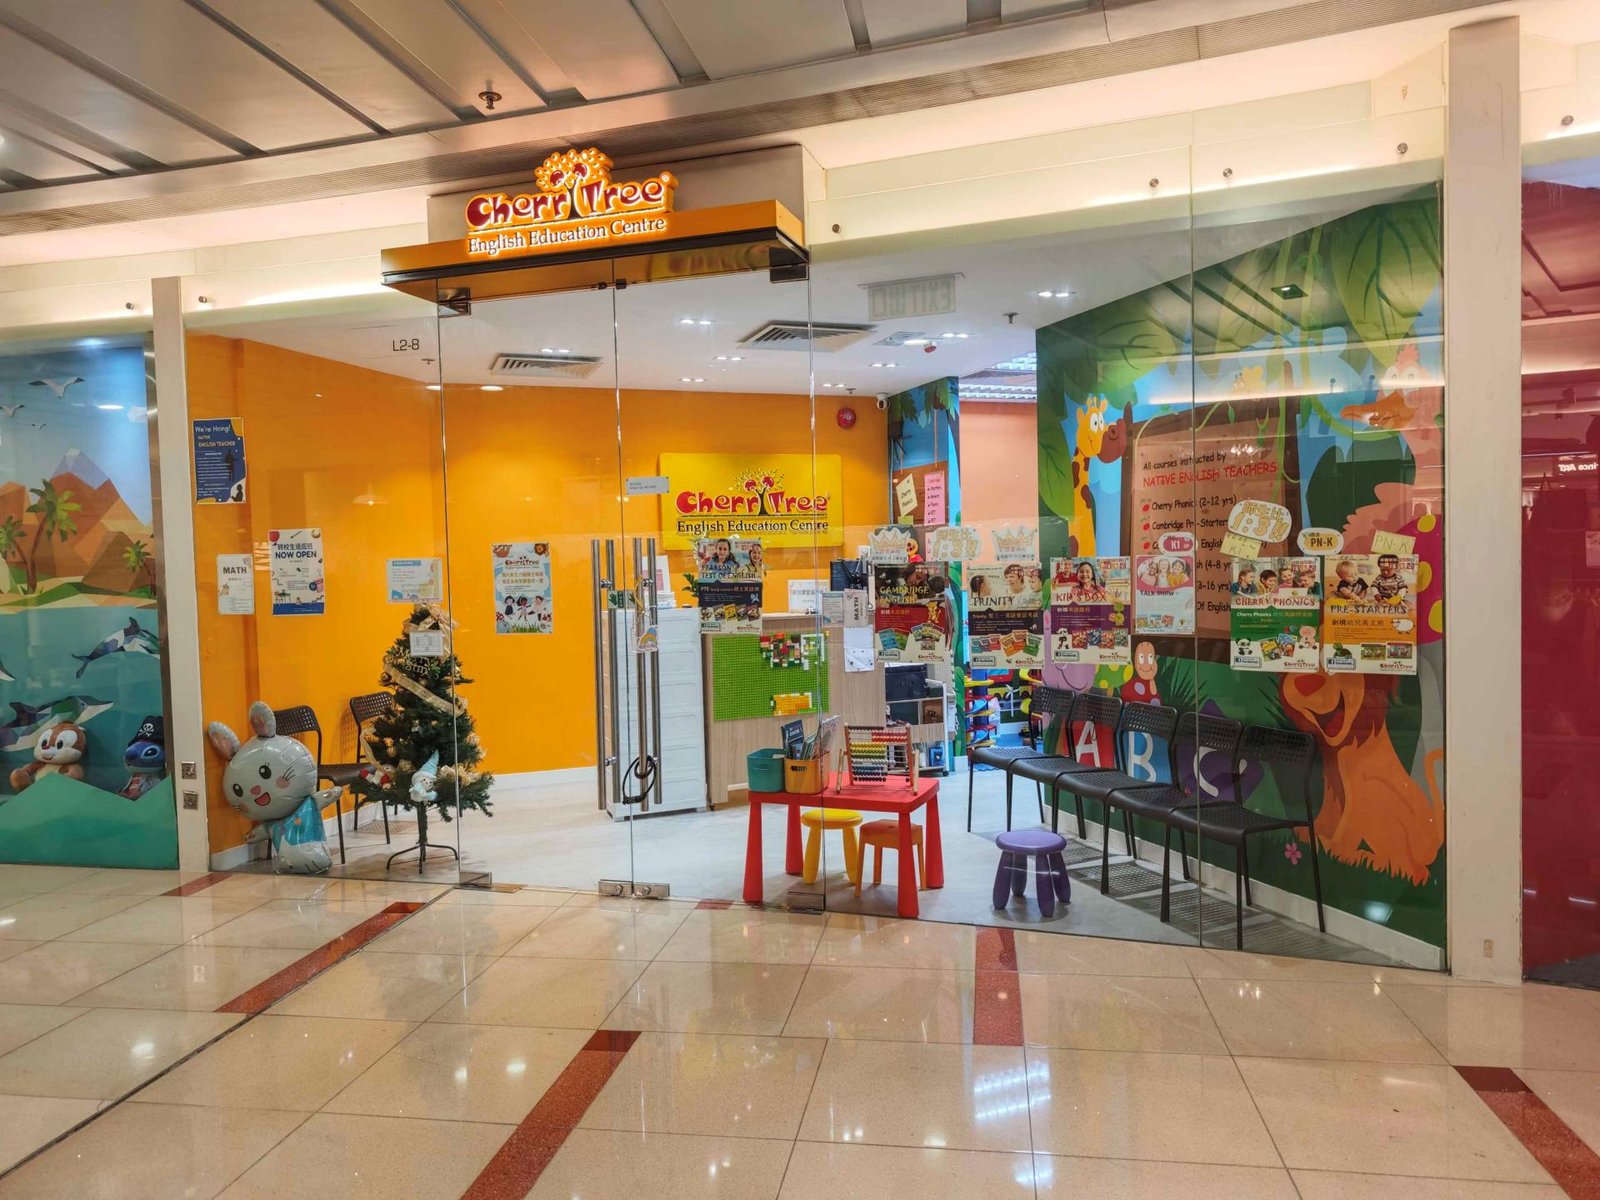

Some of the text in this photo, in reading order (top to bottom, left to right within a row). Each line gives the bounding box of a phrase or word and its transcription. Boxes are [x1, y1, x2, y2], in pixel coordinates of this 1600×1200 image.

[580, 178, 665, 214] Tree
[468, 217, 665, 255] English Education Centre
[392, 338, 420, 352] L2-8
[195, 424, 231, 433] We're Hiring!
[1143, 461, 1151, 470] All
[1154, 460, 1177, 469] courses
[1217, 451, 1226, 463] by
[1143, 473, 1176, 487] NATIVE
[1224, 461, 1277, 478] TEACHERS
[768, 491, 828, 514] Tree
[1152, 501, 1172, 511] Cherry
[1200, 496, 1219, 508] (2-12
[1222, 495, 1236, 506] yrs)
[677, 520, 724, 535] English
[728, 519, 787, 531] Education
[1152, 520, 1184, 531] Cambridge
[1171, 540, 1179, 549] K1
[1310, 537, 1333, 548] PN-K
[1205, 560, 1221, 571] (4-8
[880, 586, 929, 594] CAMBRIDGE
[1218, 581, 1232, 592] yrs)
[973, 596, 1015, 606] TRINITY
[1236, 597, 1315, 606] CHERRY PHONICS
[1330, 605, 1407, 614] PRE-STARTERS
[1076, 720, 1101, 768] A
[1127, 731, 1157, 783] B
